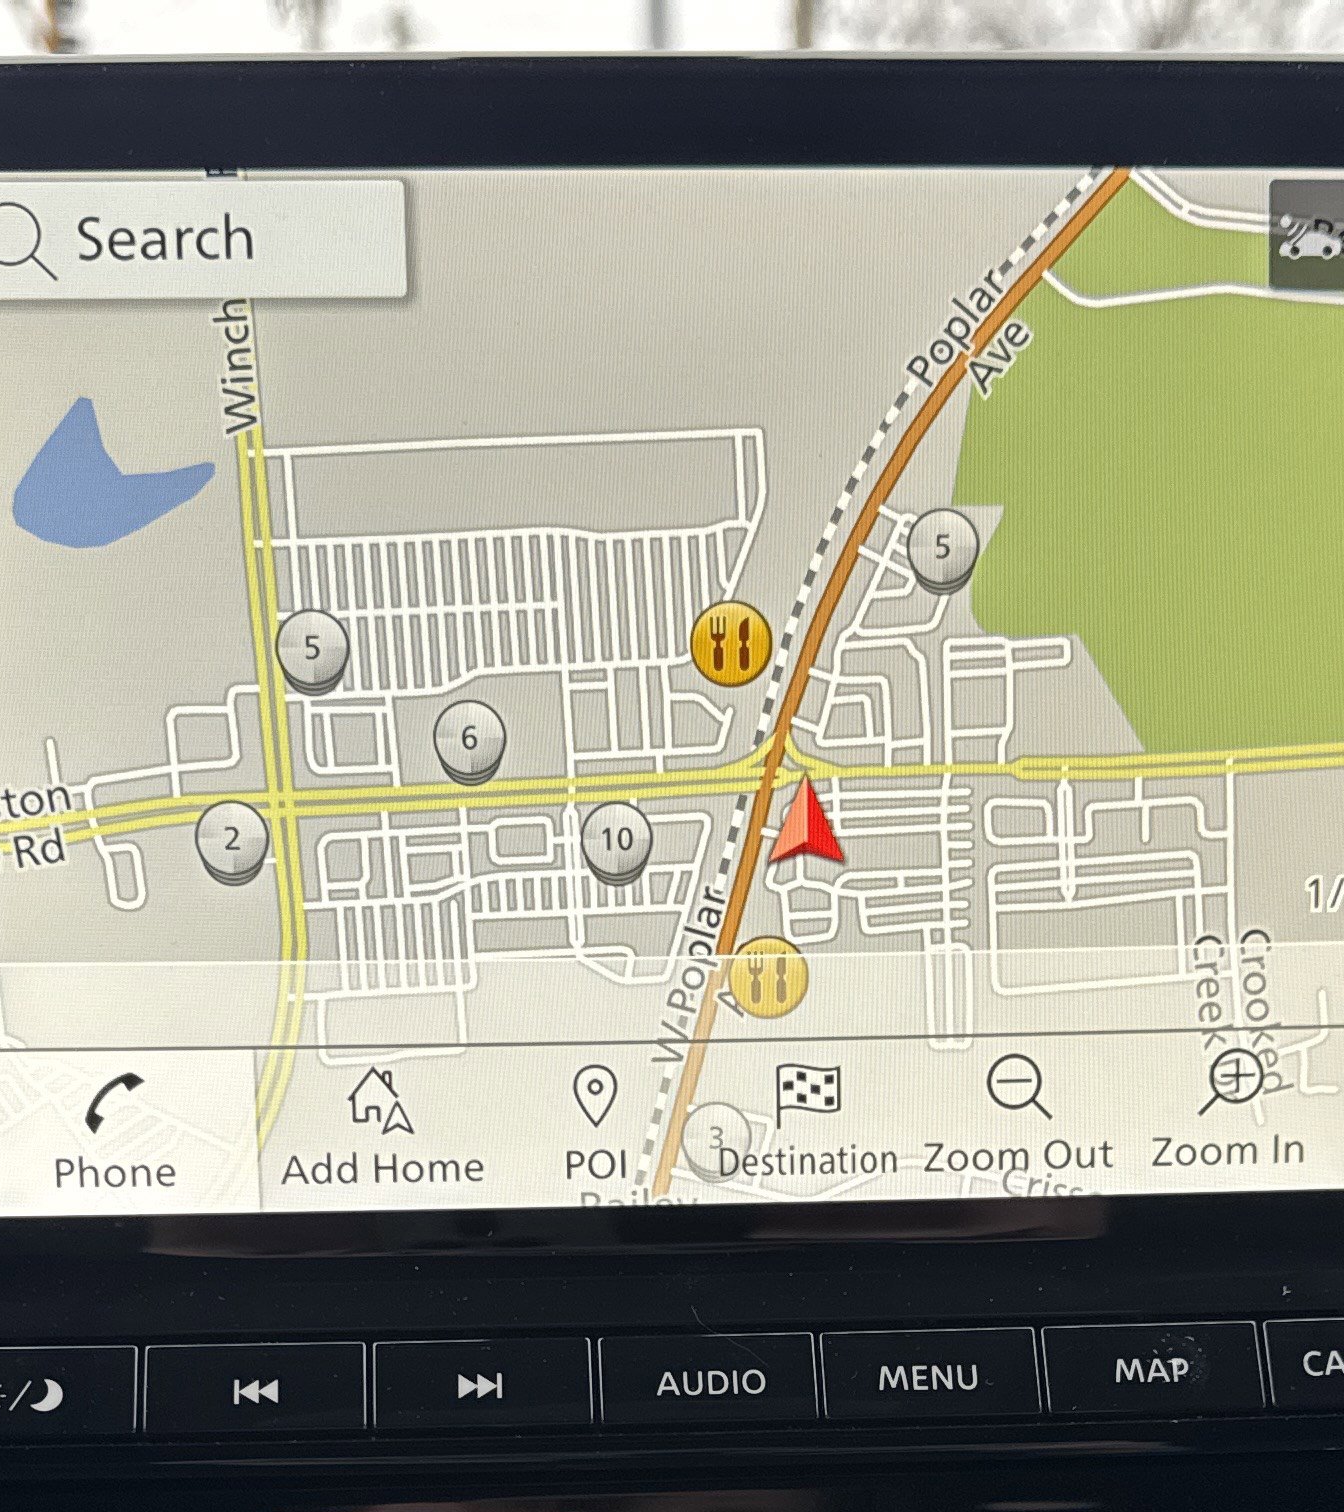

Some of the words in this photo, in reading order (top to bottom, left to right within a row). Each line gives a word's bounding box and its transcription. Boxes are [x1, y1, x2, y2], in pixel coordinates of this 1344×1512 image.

[77, 212, 254, 262] Search
[906, 268, 1004, 388] Poplar
[968, 321, 1031, 396] Ave
[935, 533, 952, 560] 5
[304, 635, 321, 661] 5
[462, 726, 478, 751] 6
[13, 827, 66, 869] Rd
[224, 826, 240, 851] 2
[600, 825, 633, 851] 10
[666, 885, 726, 1014] Poplar
[1192, 935, 1234, 1052] Creek
[1240, 929, 1296, 1096] Crooked
[651, 1019, 689, 1063] W
[709, 1126, 724, 1149] 3
[1152, 1137, 1258, 1168] Zoom
[1272, 1134, 1305, 1164] In
[281, 1155, 359, 1187] Add
[373, 1155, 485, 1184] Home
[565, 1150, 628, 1180] POI
[719, 1144, 898, 1178] Destination
[923, 1142, 1030, 1173] Zoom
[1044, 1139, 1114, 1169] Out
[54, 1157, 177, 1190] Phone
[657, 1369, 766, 1398] AUDIO
[878, 1364, 979, 1392] MENU
[1114, 1356, 1190, 1384] MAP
